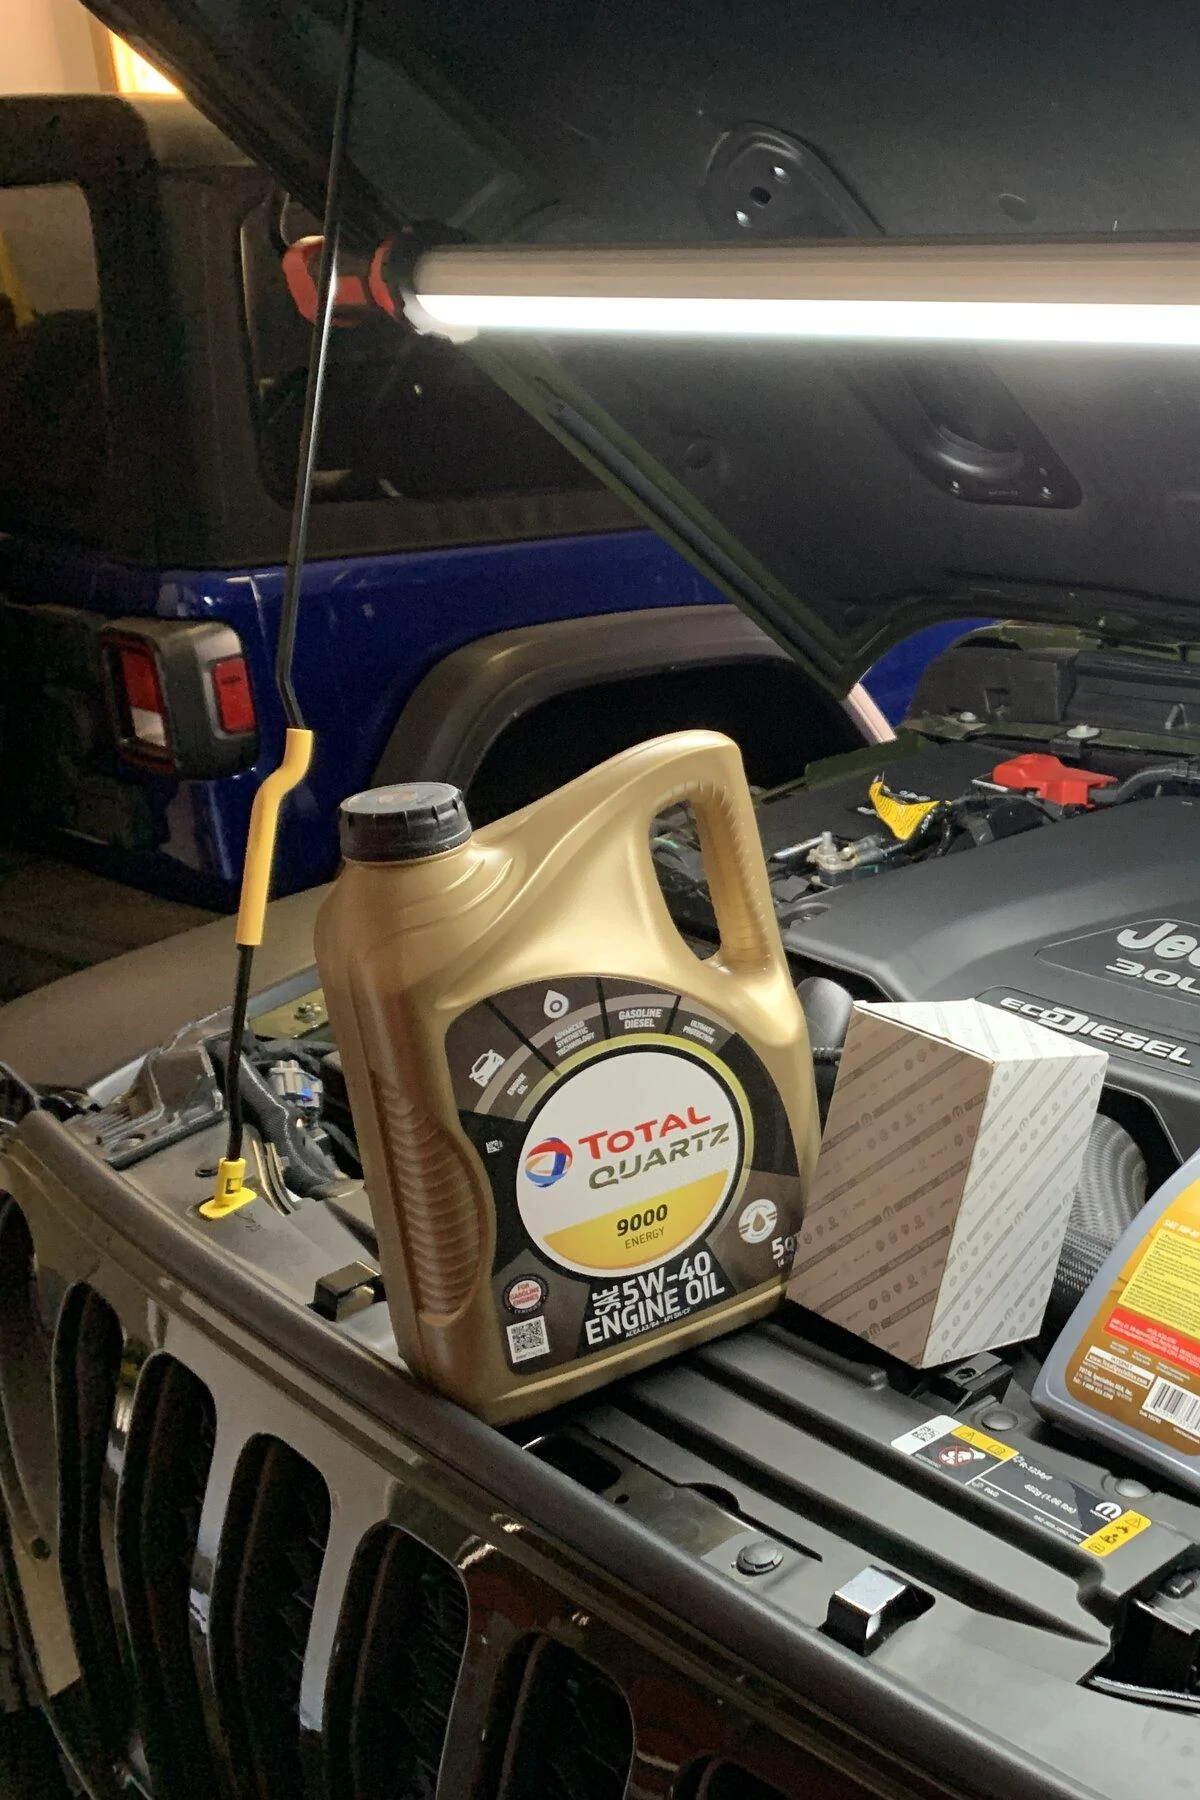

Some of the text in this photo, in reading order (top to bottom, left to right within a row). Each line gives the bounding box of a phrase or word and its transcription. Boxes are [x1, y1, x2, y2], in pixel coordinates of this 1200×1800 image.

[618, 1008, 662, 1021] GASOLINE
[624, 1018, 656, 1029] DIESEL
[577, 1106, 712, 1160] TOTAL
[588, 1122, 730, 1189] QUARTZ
[616, 1203, 668, 1237] 9000
[624, 1227, 665, 1249] ENERGY
[622, 1251, 712, 1306] 5W-40
[584, 1272, 725, 1345] ENGINE OIL
